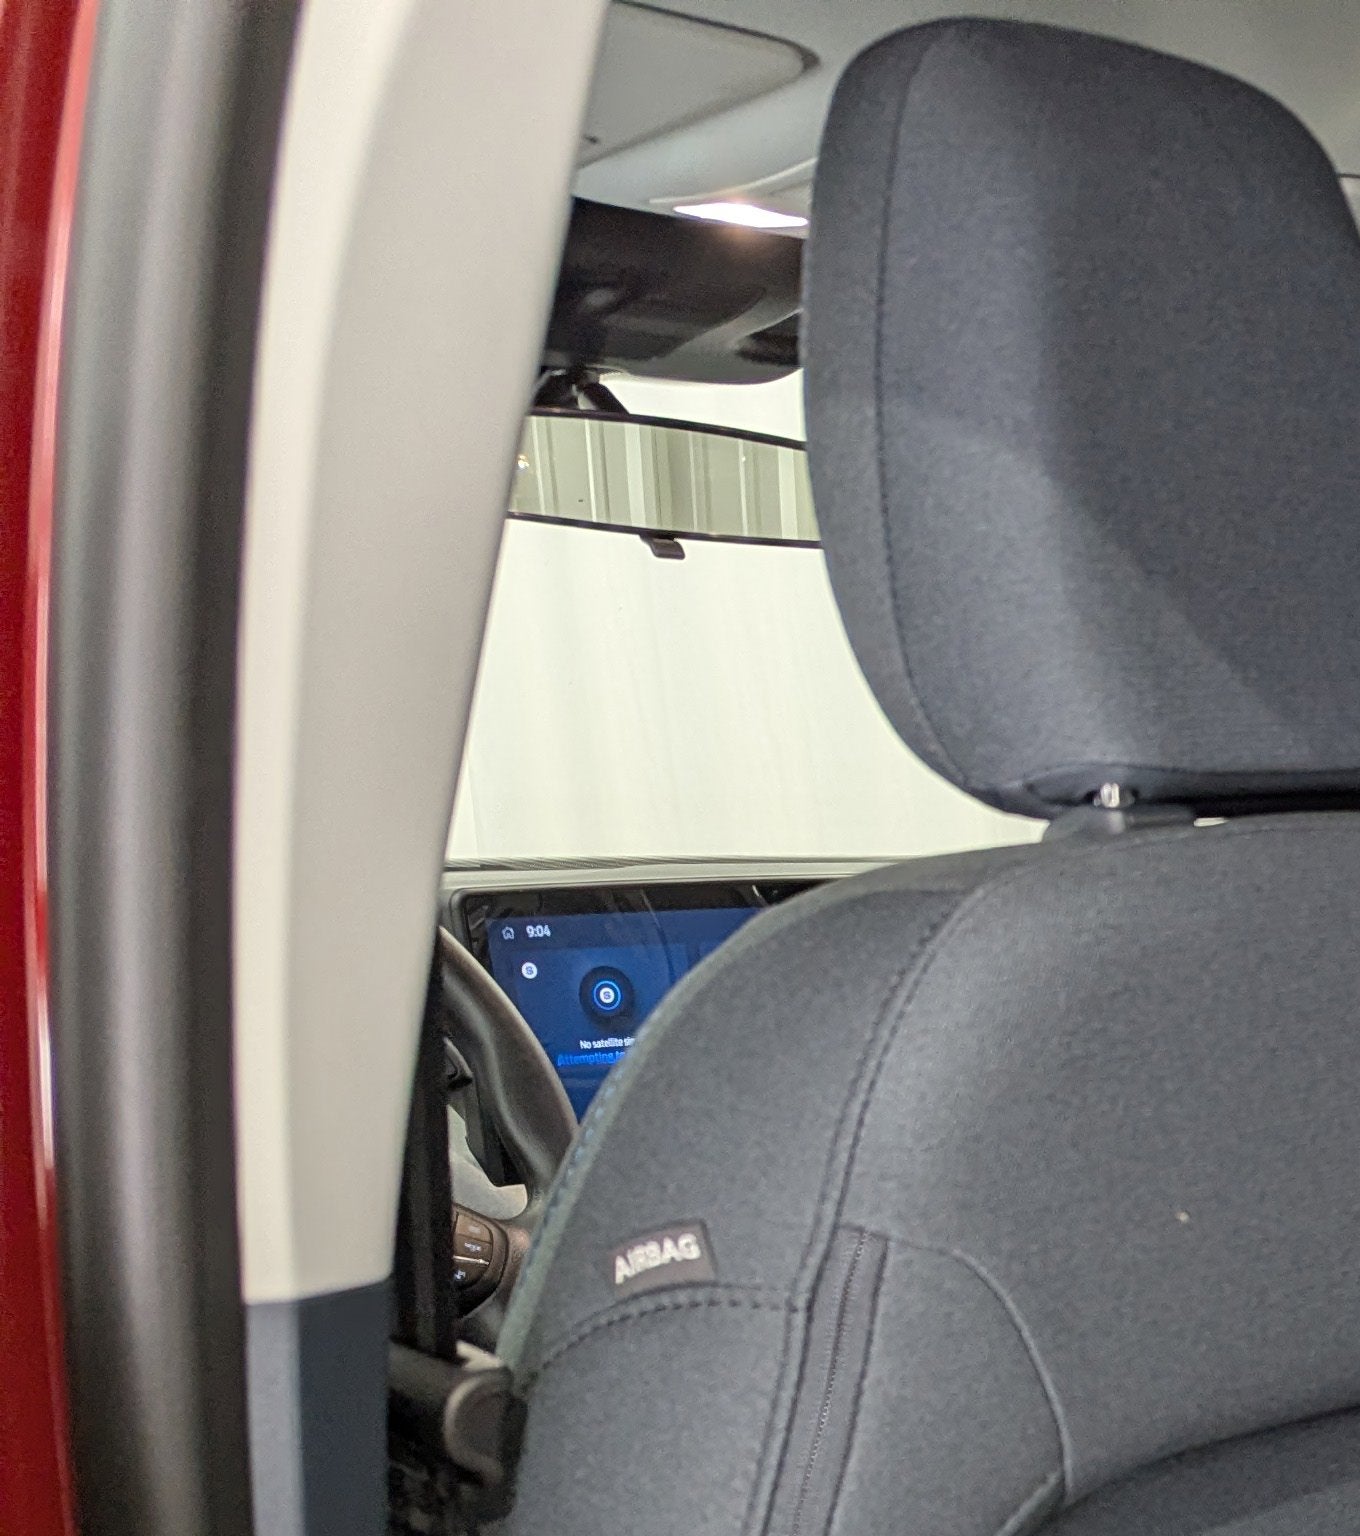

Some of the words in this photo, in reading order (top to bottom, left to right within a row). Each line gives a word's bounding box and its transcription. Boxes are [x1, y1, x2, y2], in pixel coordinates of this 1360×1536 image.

[526, 925, 551, 938] 9:04
[580, 1040, 592, 1050] No
[593, 1038, 623, 1048] satellite
[557, 1052, 617, 1066] Attempting
[615, 1233, 701, 1284] AIRBAG
